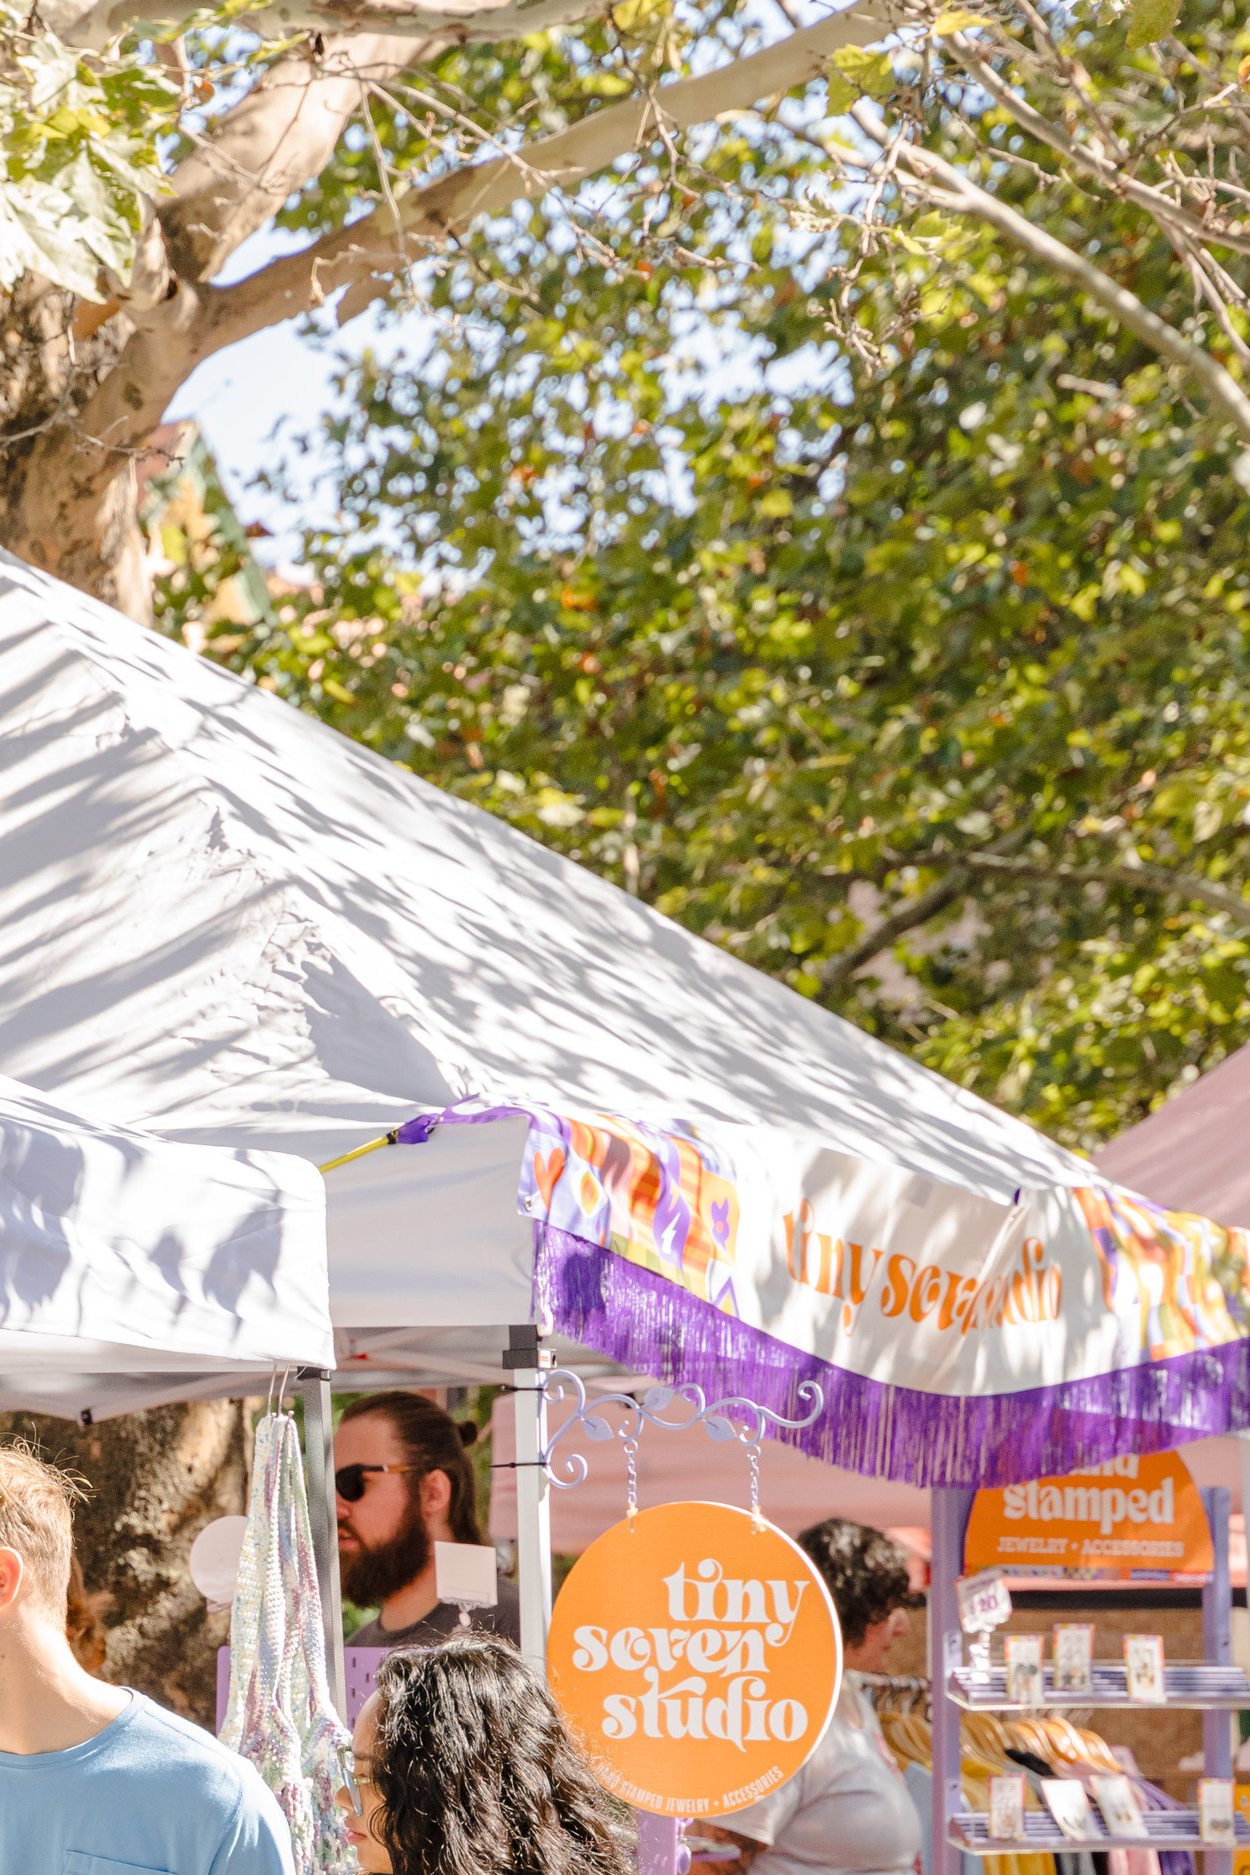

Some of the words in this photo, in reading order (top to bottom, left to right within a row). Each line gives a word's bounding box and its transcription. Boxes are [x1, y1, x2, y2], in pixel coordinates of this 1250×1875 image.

[782, 1197, 884, 1337] tiny
[881, 1253, 982, 1336] seve
[1002, 1476, 1174, 1536] stamped
[997, 1536, 1068, 1555] JEWELRY
[662, 1558, 810, 1648] tiny
[572, 1625, 770, 1678] seven
[602, 1666, 808, 1752] studio
[619, 1780, 664, 1810] STAMPED
[665, 1797, 710, 1813] JEWELRY
[722, 1765, 785, 1809] ACCESSORIES
